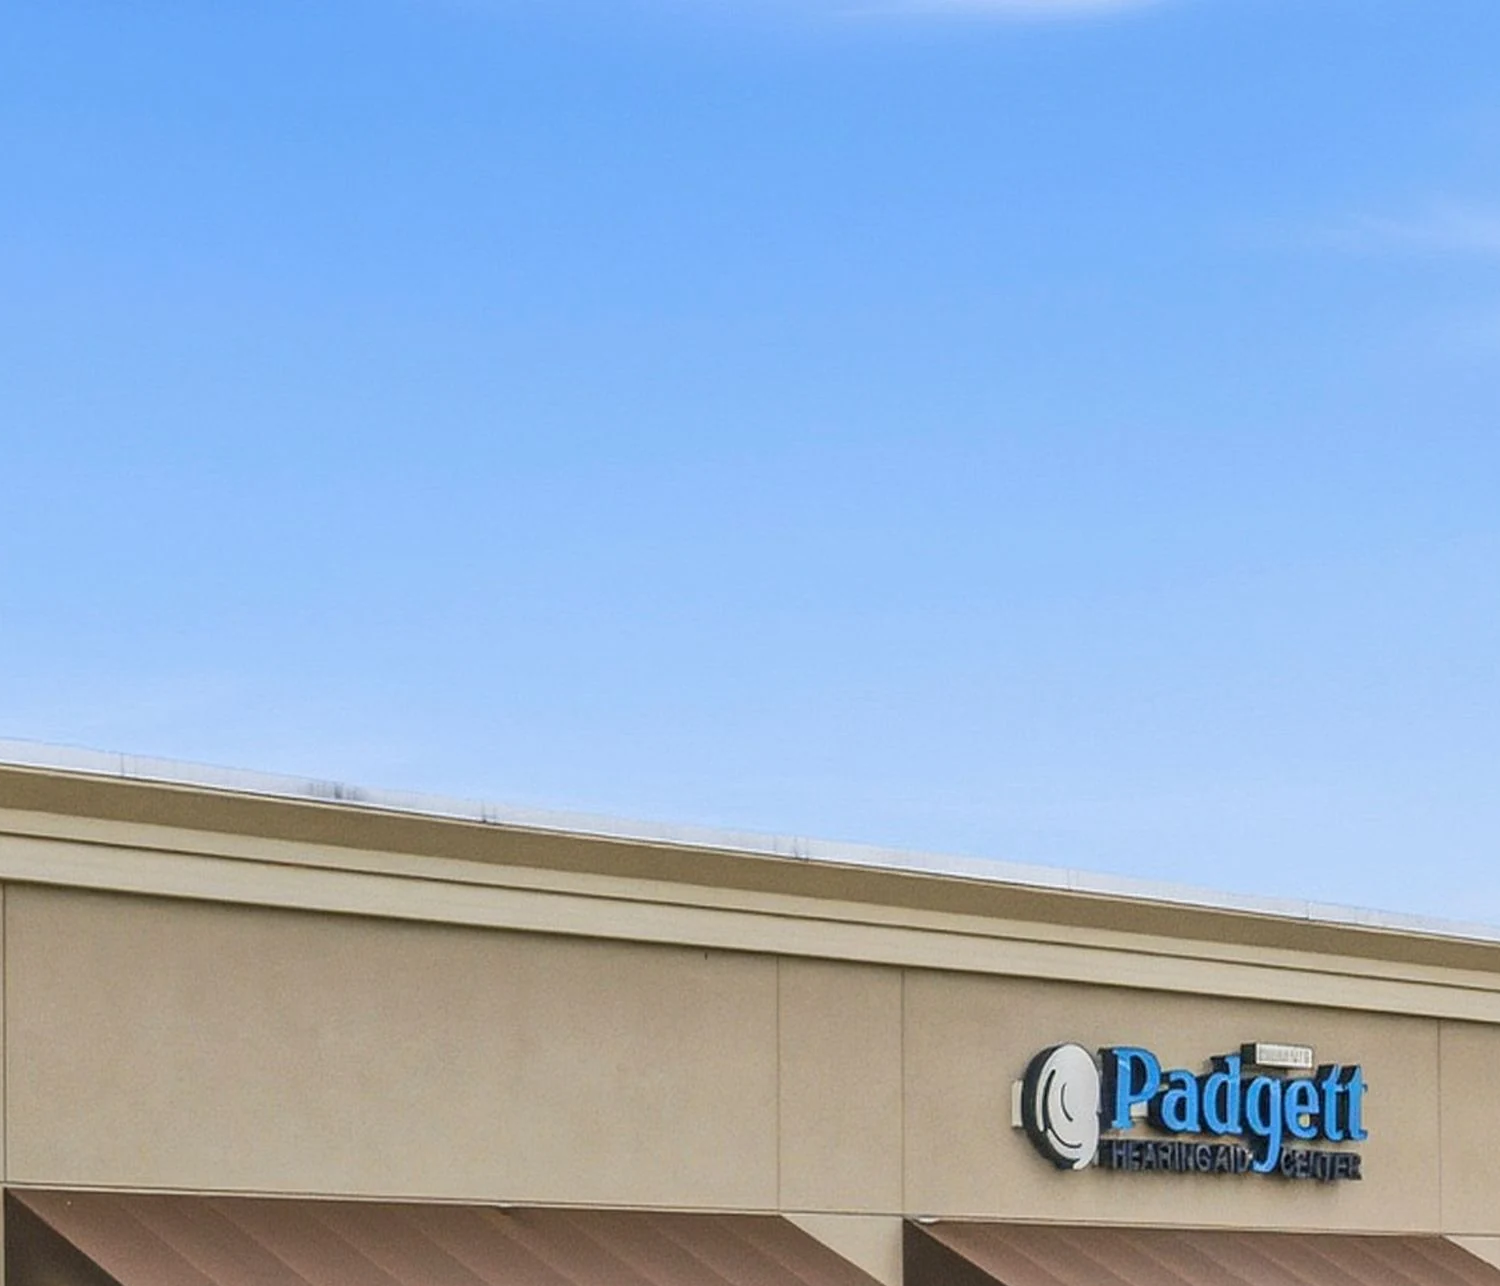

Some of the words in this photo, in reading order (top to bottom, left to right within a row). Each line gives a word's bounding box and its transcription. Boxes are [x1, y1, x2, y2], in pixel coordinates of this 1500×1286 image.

[1111, 1046, 1368, 1173] Padgett
[1111, 1142, 1213, 1173] HEARING
[1280, 1150, 1363, 1181] CENTER
